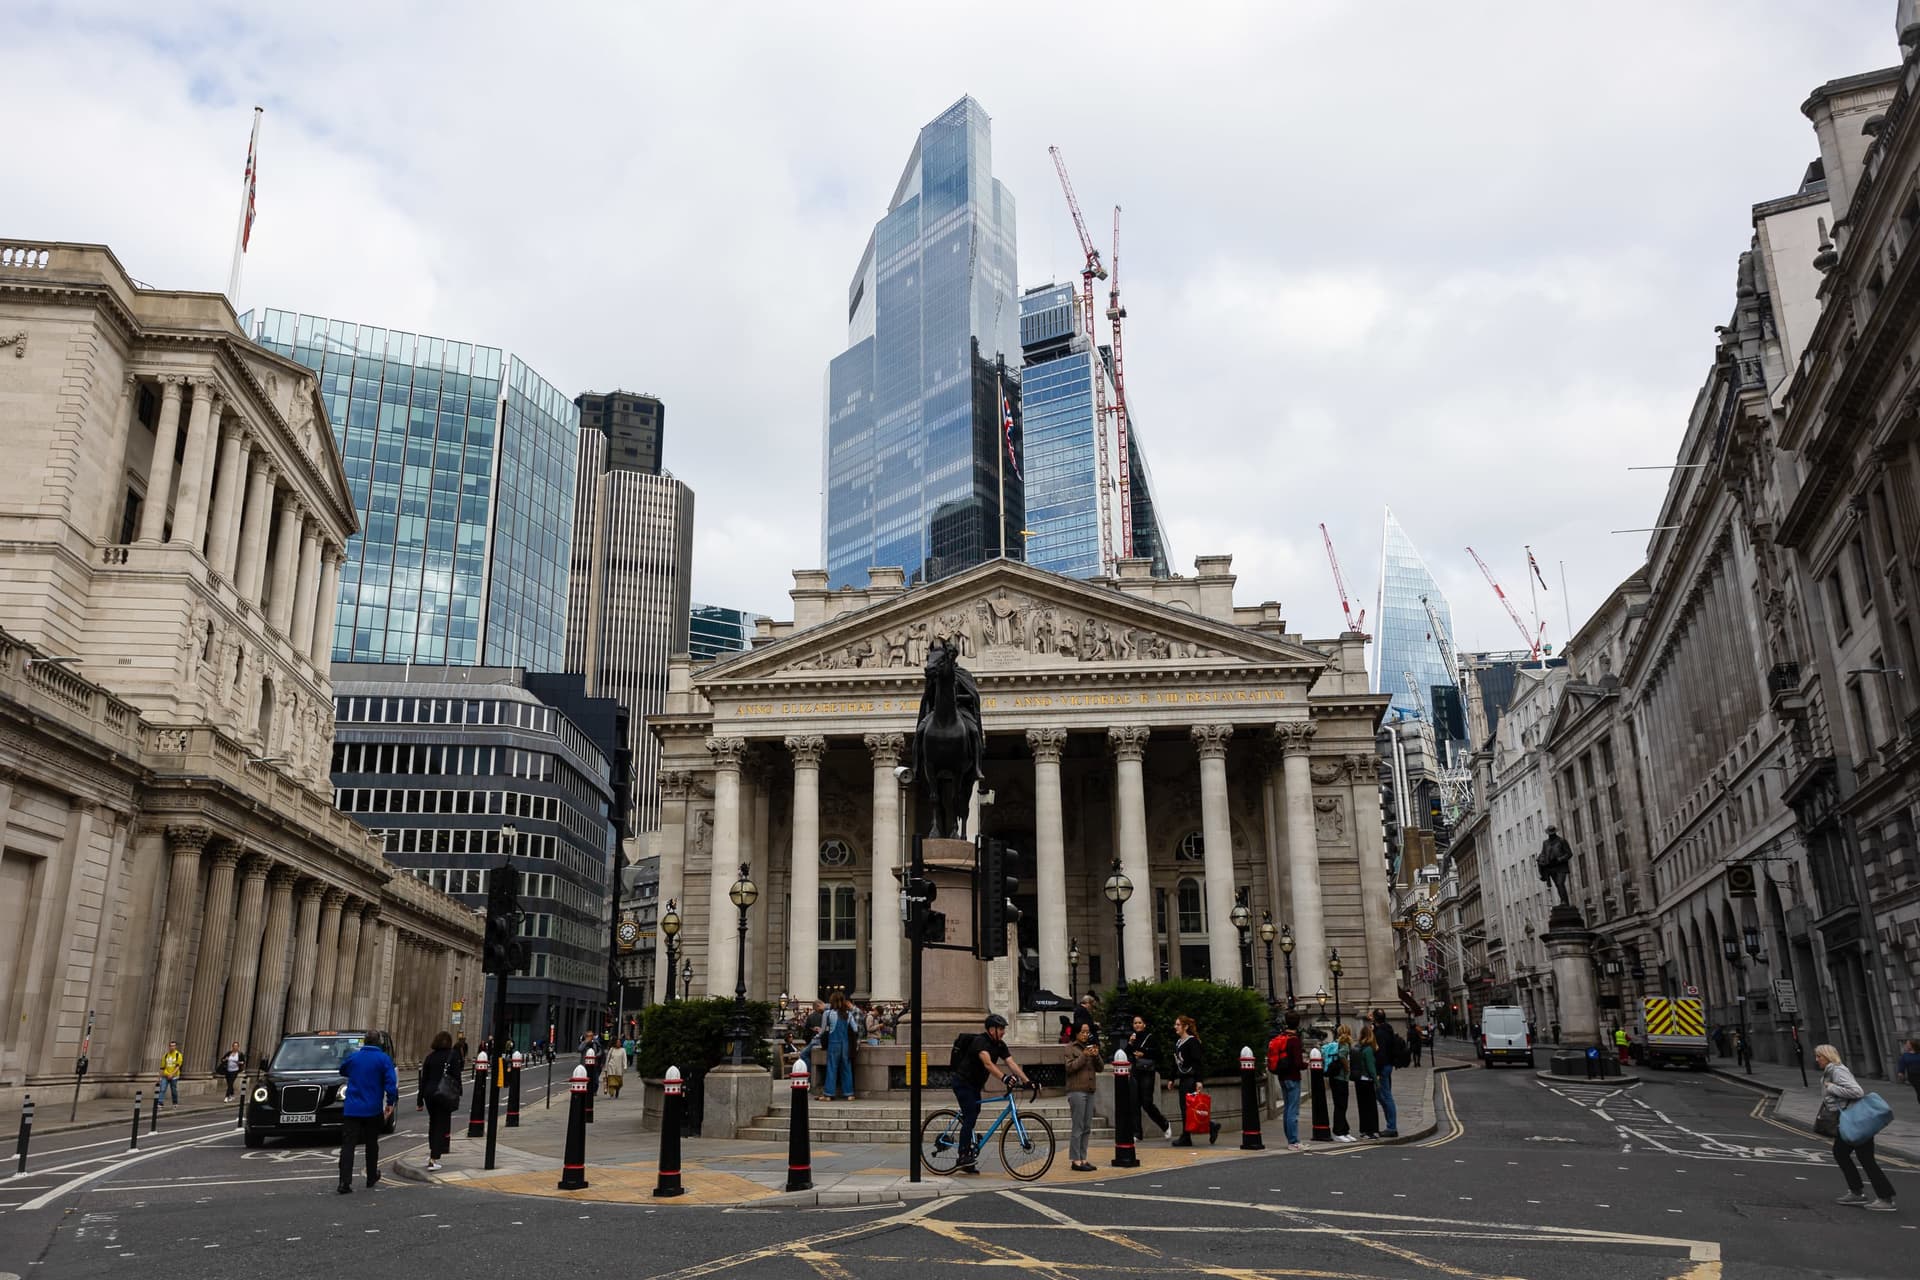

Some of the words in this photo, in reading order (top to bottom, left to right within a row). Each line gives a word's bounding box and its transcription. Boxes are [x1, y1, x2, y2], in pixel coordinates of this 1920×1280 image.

[736, 704, 773, 716] ANNO
[781, 701, 874, 714] ELIZABETHAE
[1014, 696, 1053, 707] ANNO
[1060, 694, 1132, 706] VICTORIAE
[1186, 689, 1286, 704] RESTAVRATVM
